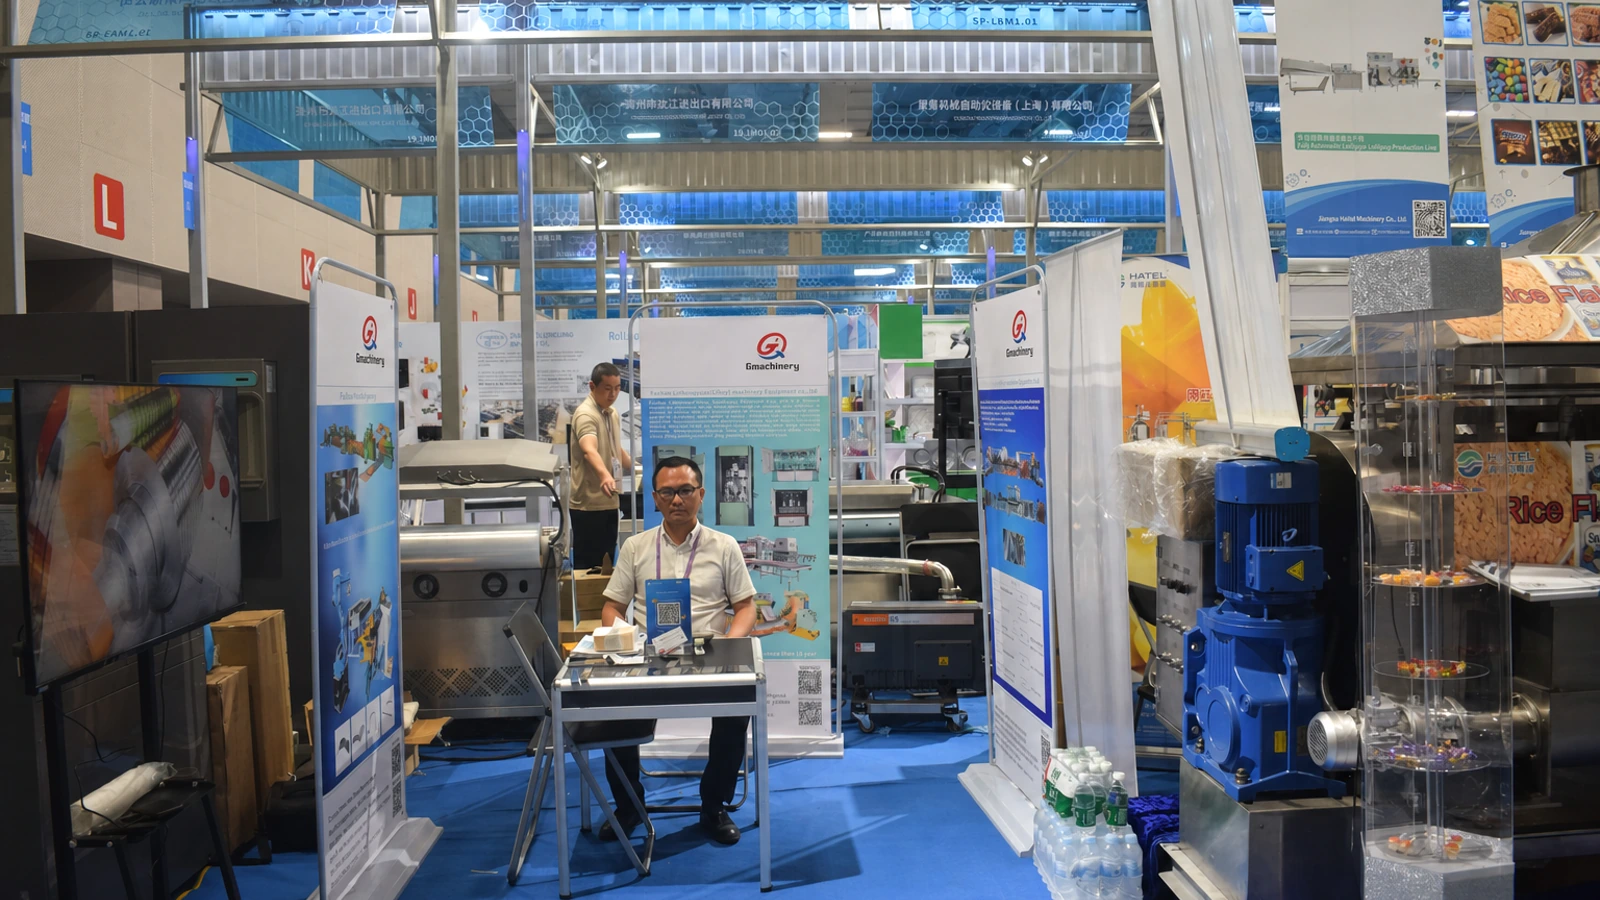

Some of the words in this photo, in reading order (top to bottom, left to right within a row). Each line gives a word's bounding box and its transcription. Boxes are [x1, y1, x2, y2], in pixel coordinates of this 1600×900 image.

[102, 184, 117, 230] L
[1129, 272, 1167, 280] HATEL
[411, 293, 416, 315] J
[1502, 286, 1550, 304] ice
[745, 362, 800, 371] Gmachinery
